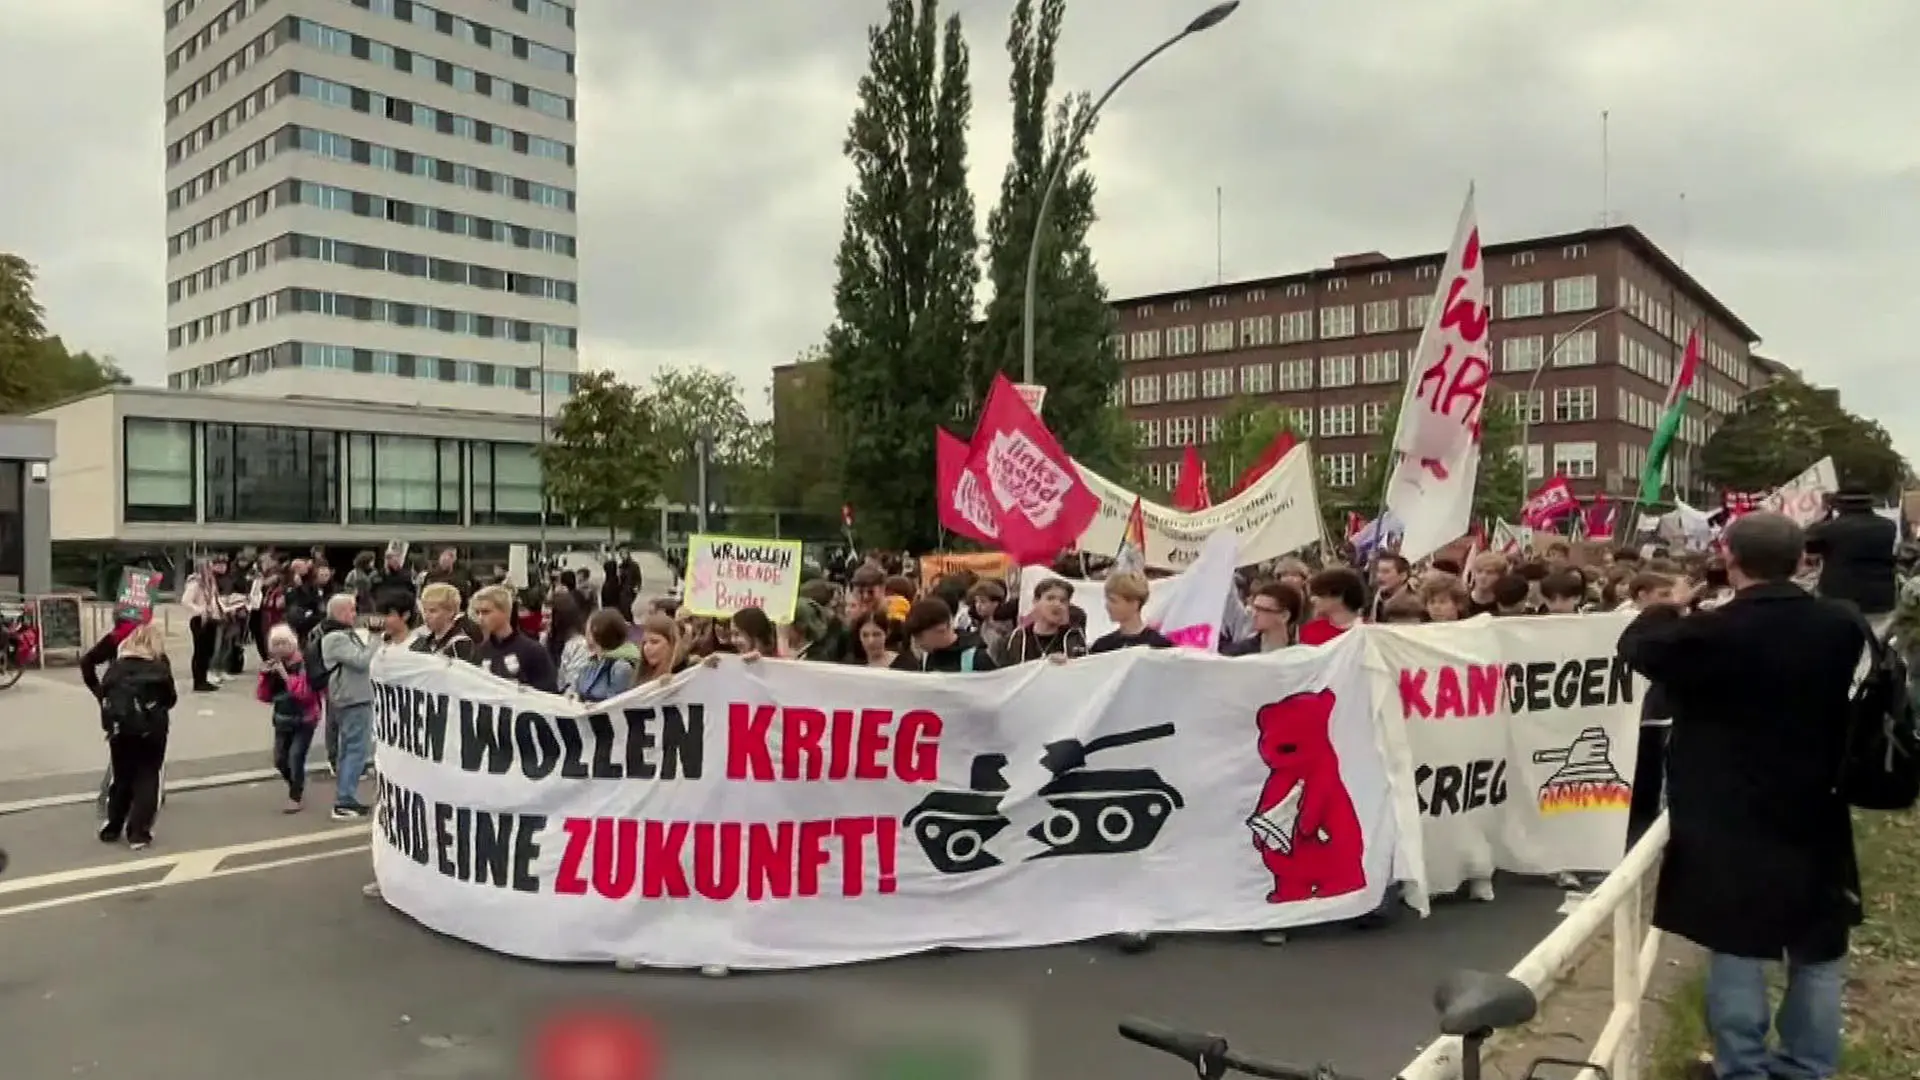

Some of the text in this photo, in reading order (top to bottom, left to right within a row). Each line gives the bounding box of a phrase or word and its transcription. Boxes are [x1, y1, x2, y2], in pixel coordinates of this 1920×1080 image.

[736, 545, 792, 569] WOLLEN
[1398, 656, 1634, 719] KAN GEGEN
[460, 699, 705, 781] WOLLEN
[726, 703, 944, 783] KRIEG
[434, 801, 549, 892] EINE
[554, 816, 898, 901] ZUKUNFT!
